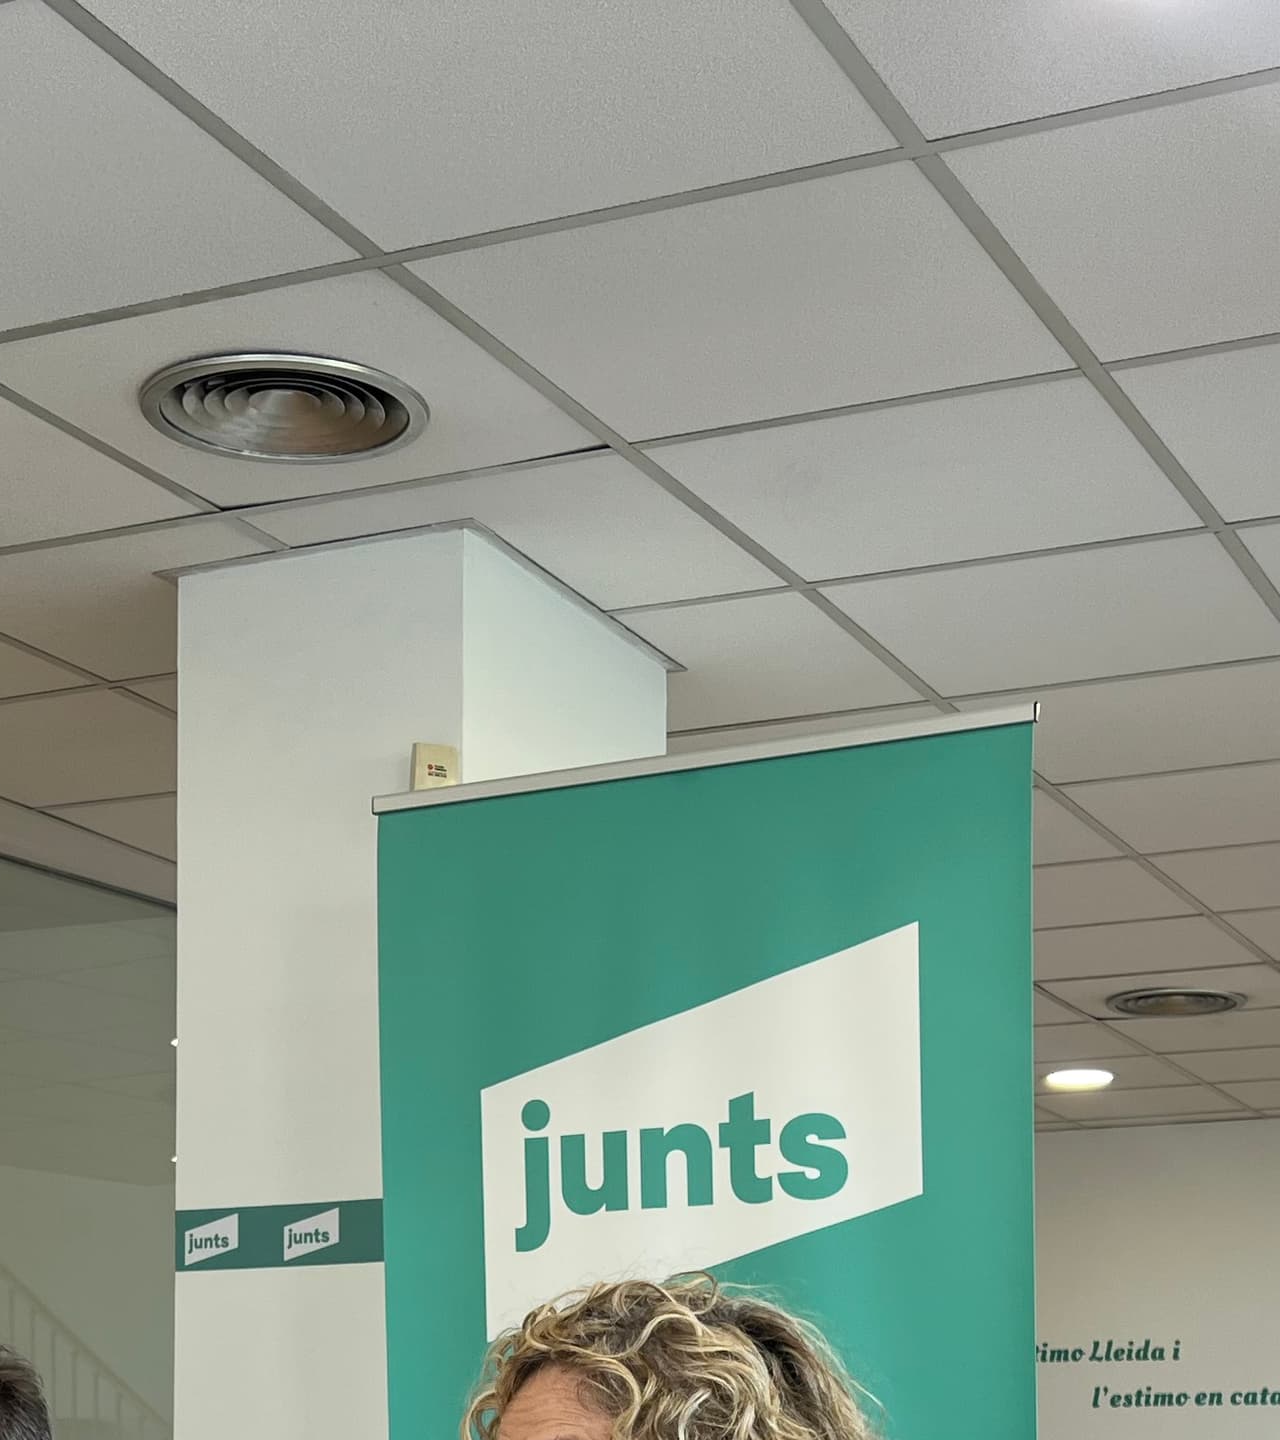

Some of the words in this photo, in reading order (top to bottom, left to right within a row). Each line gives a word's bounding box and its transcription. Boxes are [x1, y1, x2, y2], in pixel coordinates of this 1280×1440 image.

[515, 1091, 849, 1252] junts
[188, 1233, 230, 1254] junts
[287, 1228, 330, 1249] junts
[1089, 1339, 1166, 1363] Lleida
[1172, 1340, 1181, 1361] i
[1195, 1389, 1224, 1407] en
